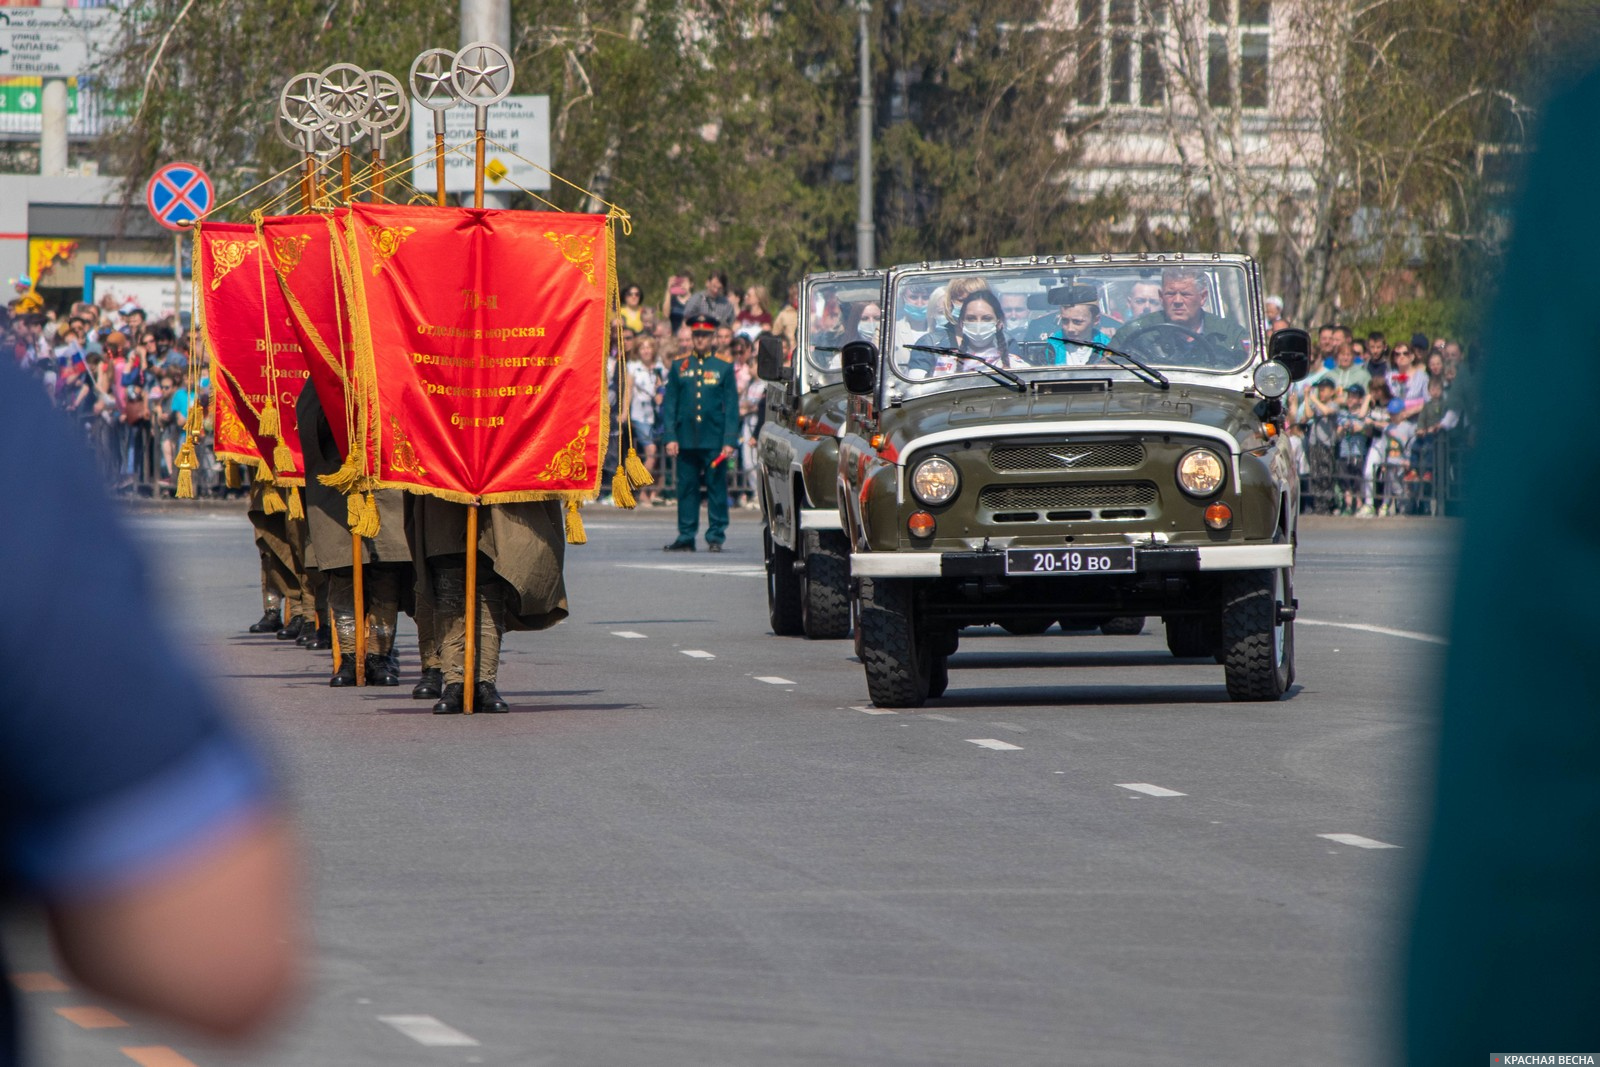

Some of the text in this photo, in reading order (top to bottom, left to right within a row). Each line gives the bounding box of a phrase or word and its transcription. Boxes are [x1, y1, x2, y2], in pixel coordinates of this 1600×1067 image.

[12, 34, 40, 42] улица
[12, 43, 59, 51] ЧАПАЕВА
[12, 54, 40, 62] улица
[12, 63, 60, 72] ПЕВЦОВА
[502, 101, 523, 109] Путь
[511, 129, 519, 138] И
[427, 159, 474, 169] ДРОГИ
[462, 289, 498, 310] 70-я
[1034, 552, 1081, 571] 20-19
